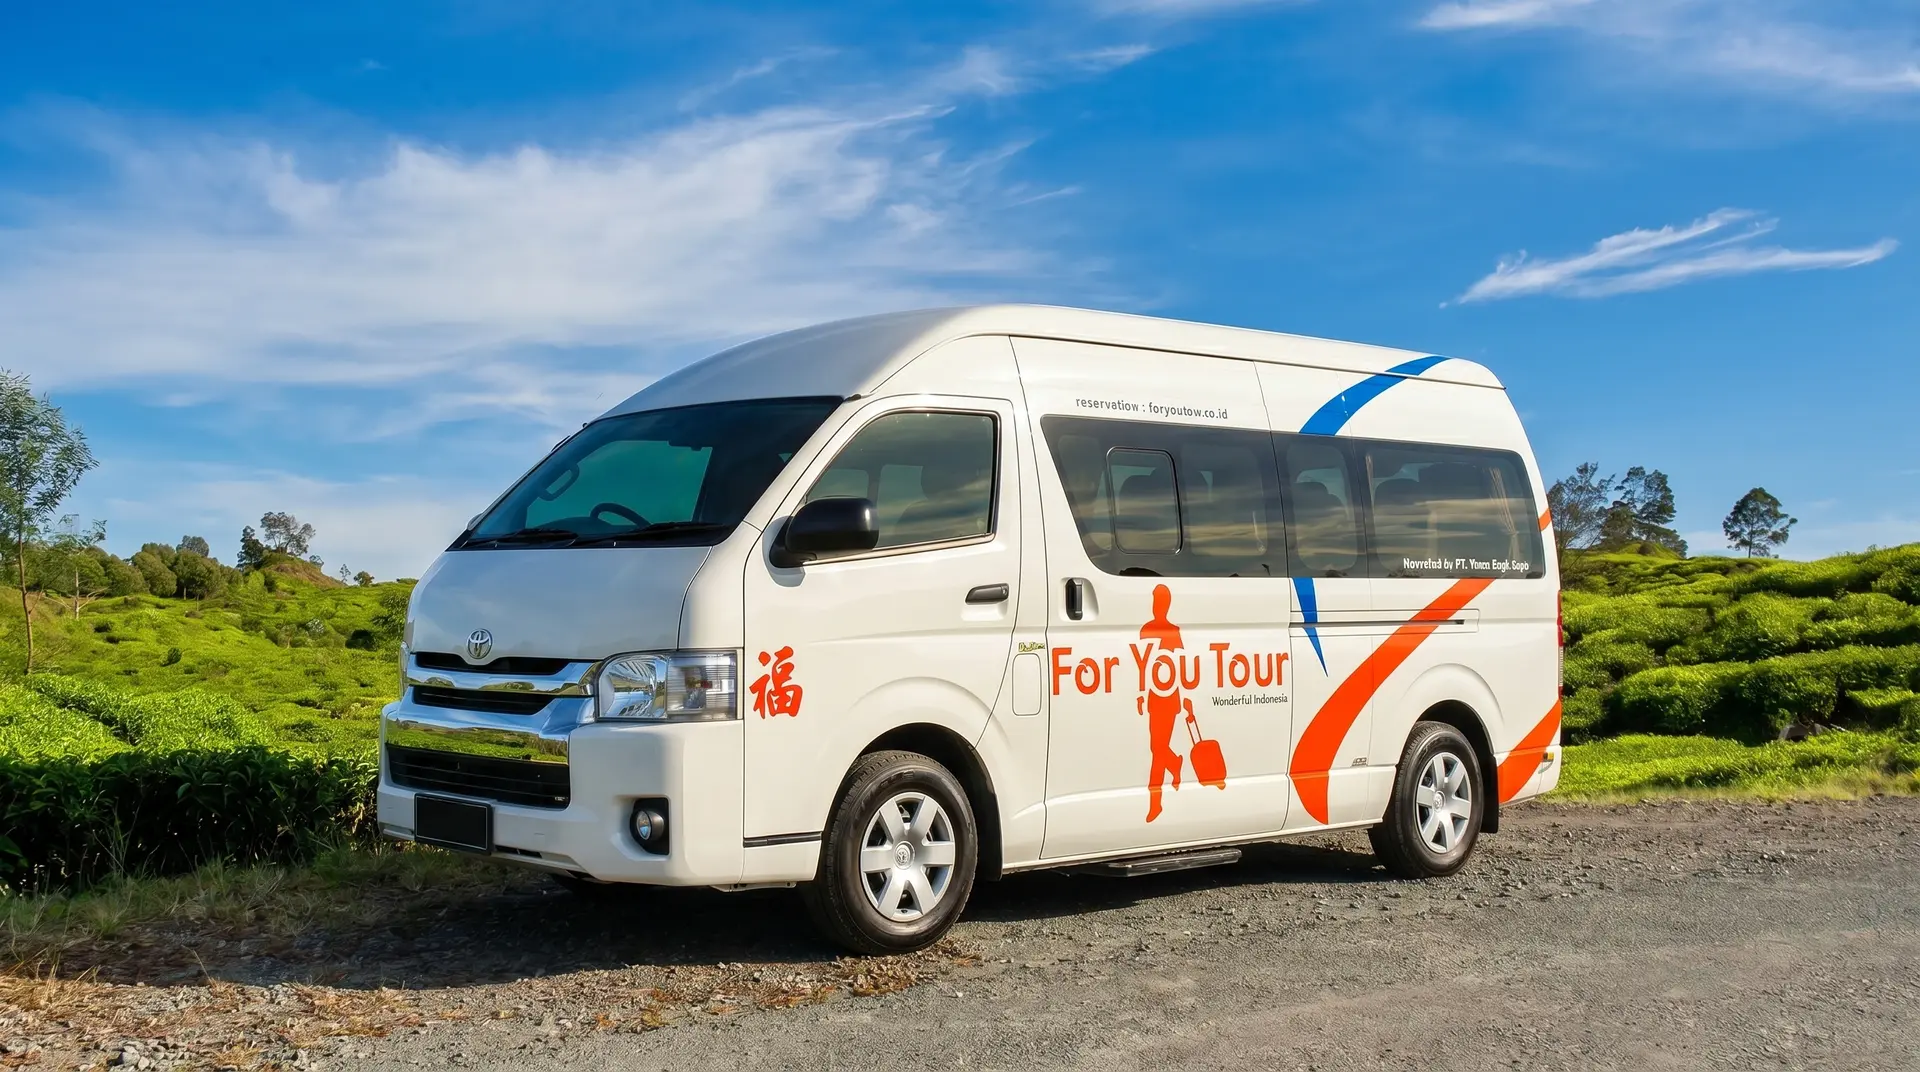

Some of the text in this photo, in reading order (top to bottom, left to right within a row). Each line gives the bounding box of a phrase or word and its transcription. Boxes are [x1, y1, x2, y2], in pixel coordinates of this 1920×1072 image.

[1455, 558, 1468, 570] PT.
[749, 645, 804, 719] 福
[1051, 642, 1289, 696] For You Tour
[1211, 693, 1288, 706] Wonderful Indonesia
